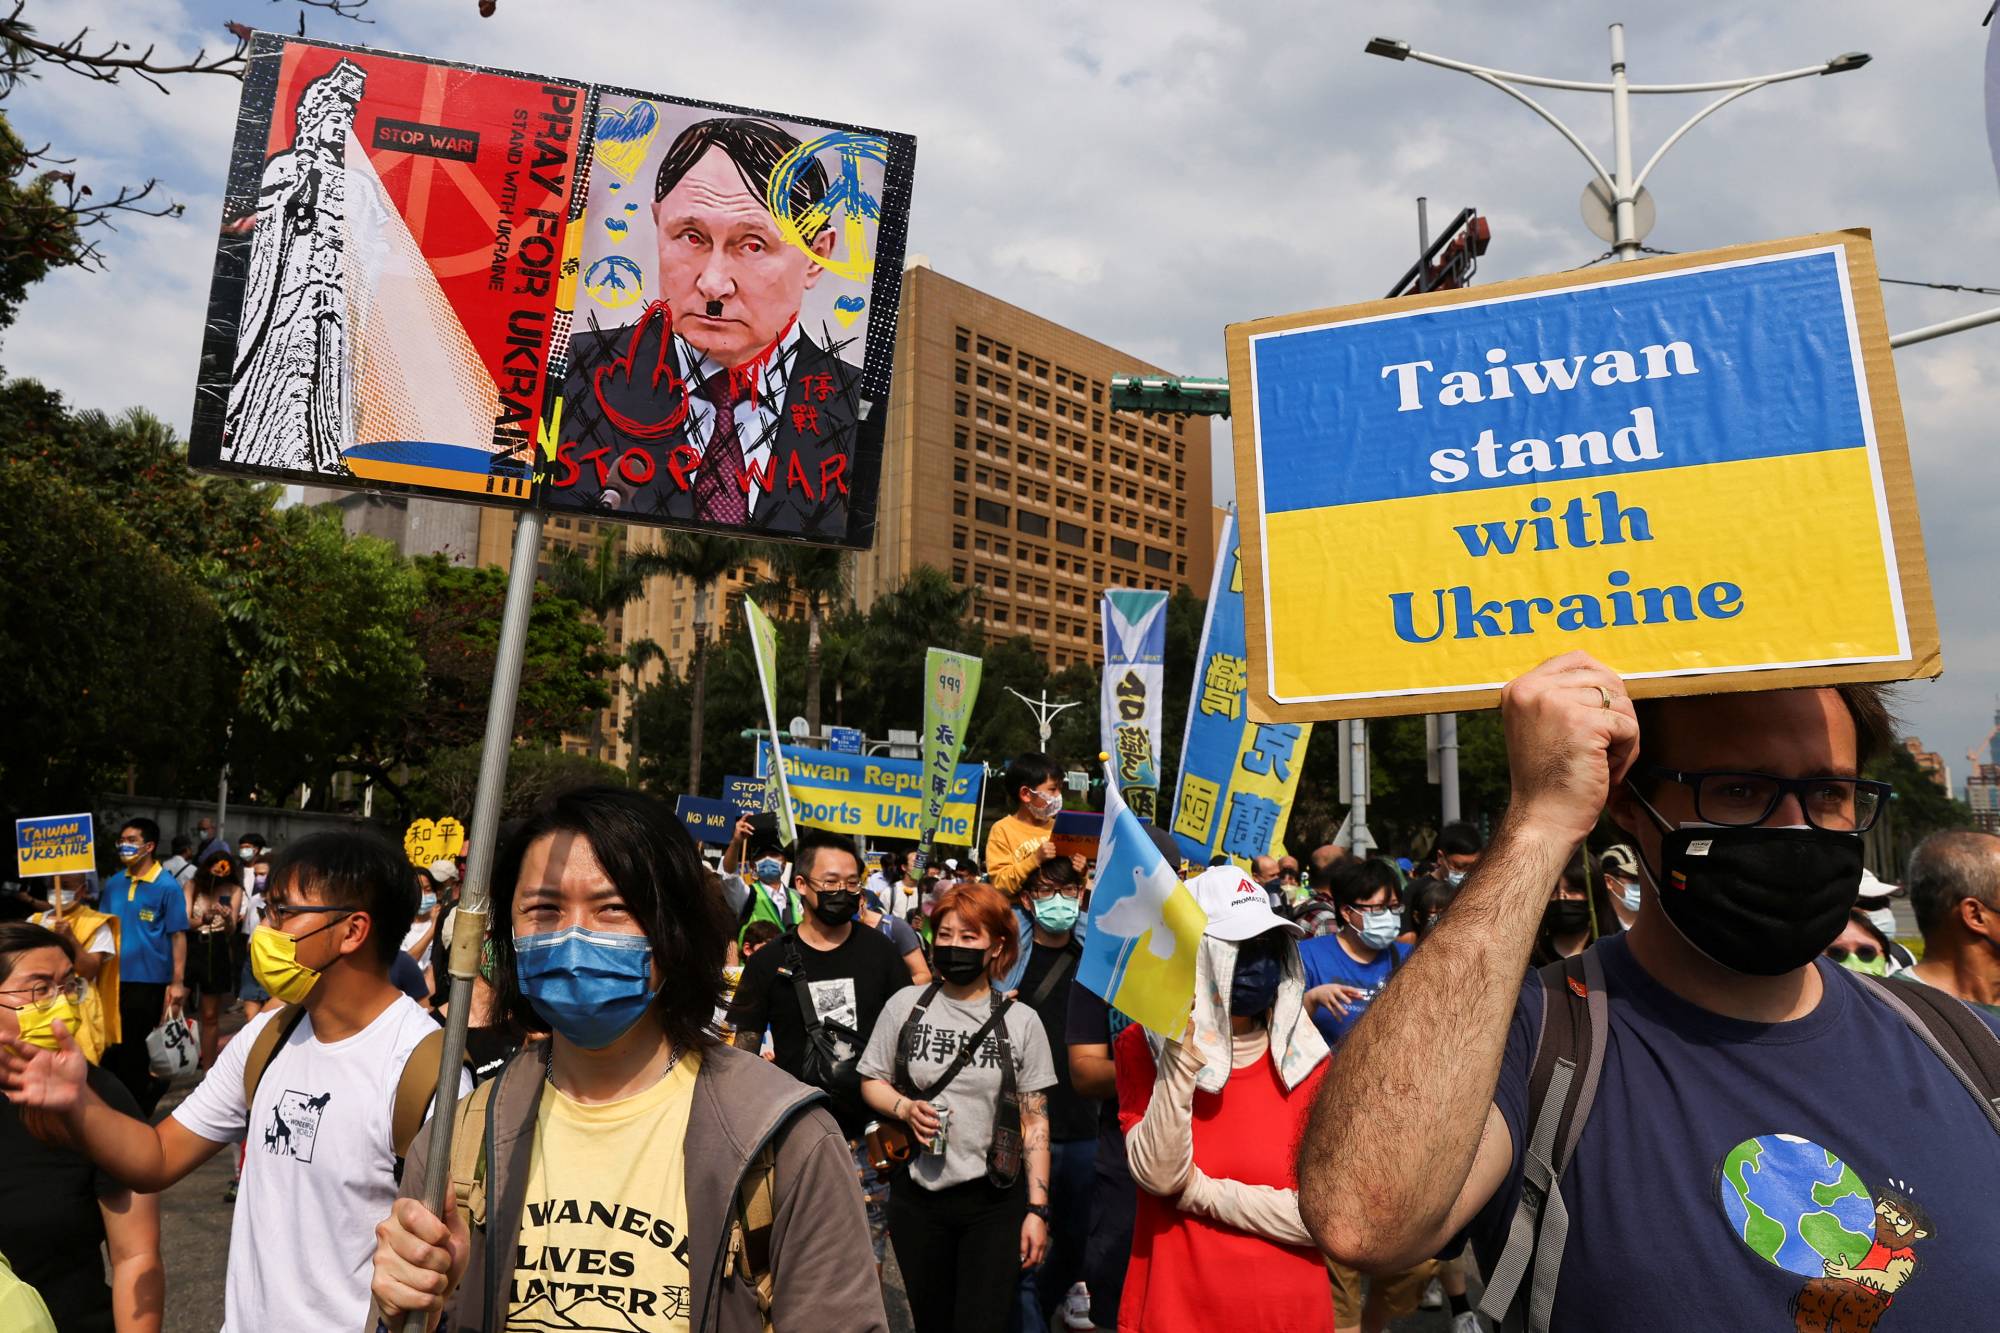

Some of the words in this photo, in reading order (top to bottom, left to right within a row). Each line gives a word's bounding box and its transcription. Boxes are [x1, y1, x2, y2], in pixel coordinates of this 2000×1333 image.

[378, 127, 424, 146] STOP
[429, 136, 473, 152] WAR!
[506, 108, 528, 165] STAND
[529, 85, 578, 197] PRAY
[499, 171, 519, 216] WITH
[488, 217, 512, 292] UKRAINE
[514, 208, 559, 296] FOR
[1381, 340, 1698, 412] Taiwan
[486, 311, 537, 495] UKRAINE
[557, 442, 701, 492] STOP
[736, 451, 848, 499] WAR
[1429, 406, 1663, 484] stand
[1454, 490, 1654, 558] with
[1390, 571, 1744, 644] Ukraine
[731, 781, 766, 792] STOP
[765, 748, 849, 783] aiwan
[864, 765, 968, 796] Repuc
[22, 822, 79, 842] TAIWAN
[409, 823, 458, 844] 和平
[706, 813, 726, 827] WAR
[790, 797, 861, 829] pports
[876, 803, 967, 836] Ukrne
[21, 844, 89, 862] UKRAINE
[515, 1244, 635, 1278] LIVES
